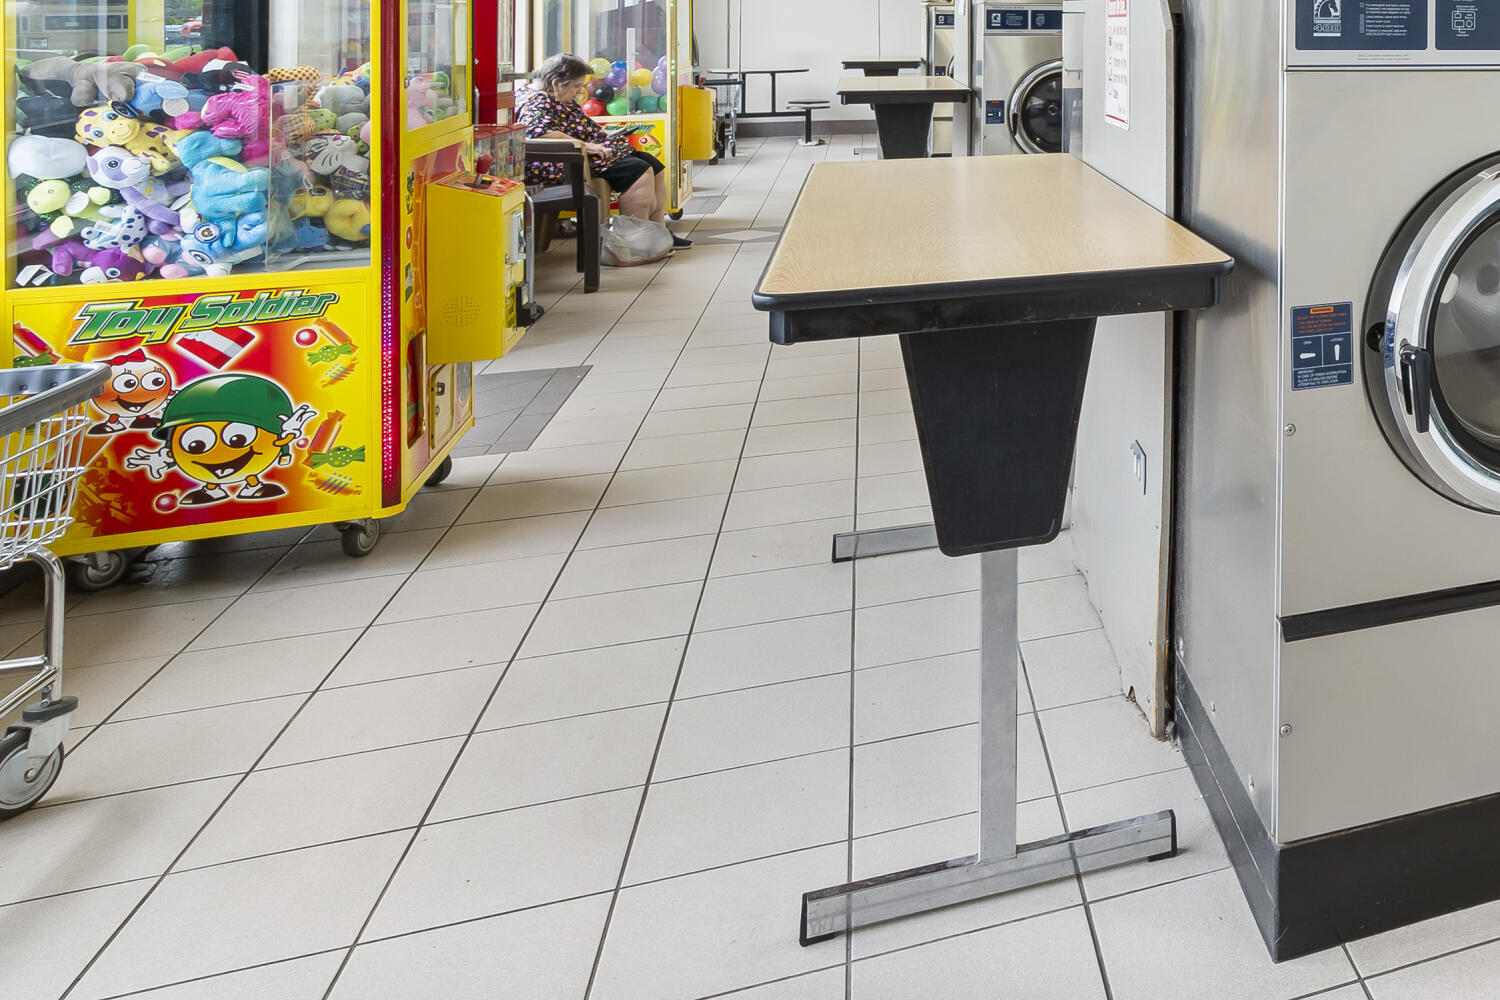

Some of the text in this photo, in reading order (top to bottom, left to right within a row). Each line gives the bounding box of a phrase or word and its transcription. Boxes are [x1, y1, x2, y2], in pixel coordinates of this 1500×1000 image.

[1313, 23, 1341, 32] 400
[67, 289, 338, 346] Toy Soldier
